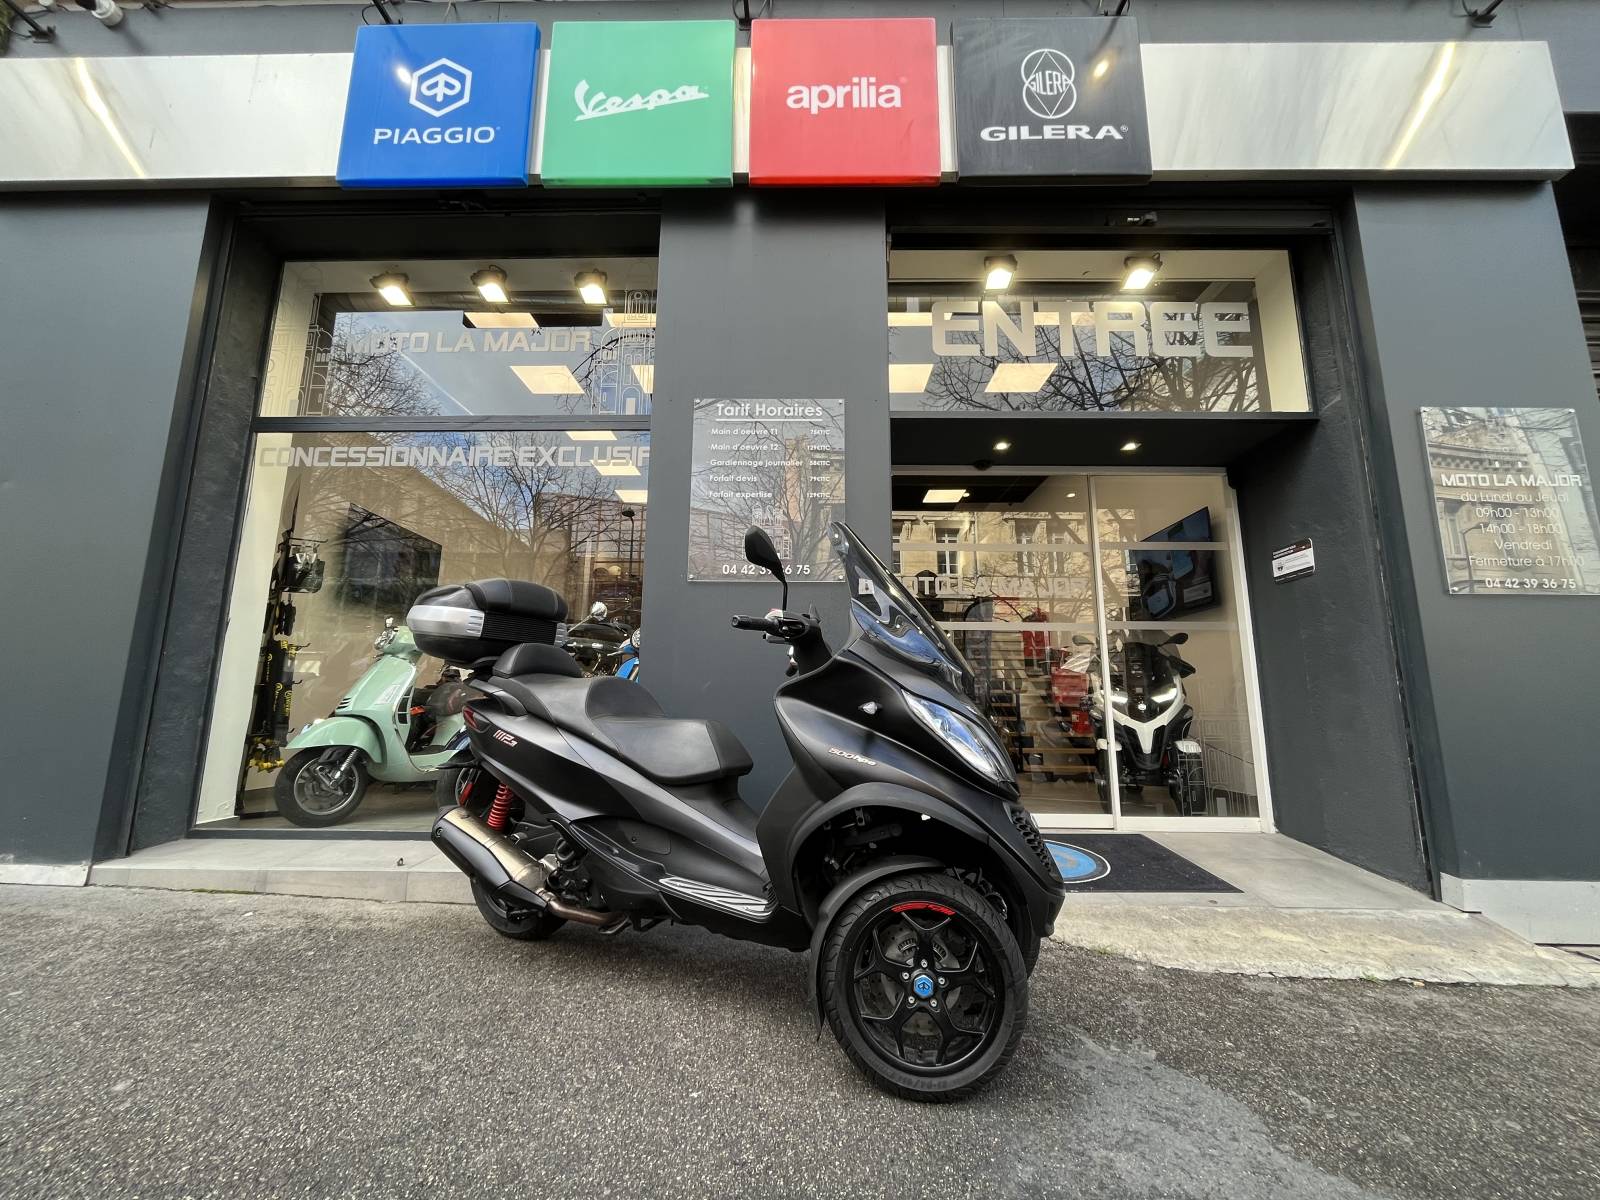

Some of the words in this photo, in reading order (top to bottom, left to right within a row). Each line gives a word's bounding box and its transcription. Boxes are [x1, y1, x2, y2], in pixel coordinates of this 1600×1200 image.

[1027, 70, 1071, 95] GILERA
[573, 79, 709, 121] Vespa
[786, 76, 902, 114] aprilia
[373, 126, 496, 145] PIAGGIO
[931, 301, 1254, 358] ENTREE
[345, 331, 430, 353] MOTO
[436, 331, 476, 352] LA
[483, 329, 592, 352] MAJOR
[716, 403, 751, 417] Tarif
[755, 403, 823, 417] Horaires
[710, 443, 731, 451] Main
[259, 446, 513, 467] CONCESSIONNAIRE
[710, 459, 764, 468] Gardiennage
[709, 474, 734, 482] Forfait
[735, 474, 758, 482] devis
[1440, 473, 1490, 487] MOTO
[1493, 473, 1518, 487] LA
[1520, 473, 1584, 487] MAJOR
[708, 490, 734, 498] Forfait
[735, 491, 773, 500] expertise
[1460, 492, 1477, 502] du
[1480, 491, 1513, 502] Lundi
[1515, 493, 1533, 502] au
[1535, 492, 1569, 503] Jeudi
[1475, 507, 1513, 518] 09h00
[1480, 523, 1516, 534] 14h00
[1494, 539, 1553, 550] Vendredi
[1468, 555, 1533, 567] Fermeture
[722, 564, 738, 575] 04
[740, 564, 756, 575] 42
[796, 564, 811, 575] 75
[1484, 577, 1501, 589] 04
[1504, 577, 1520, 589] 42
[1523, 578, 1539, 589] 39
[1542, 578, 1558, 589] 36
[1561, 578, 1577, 589] 75
